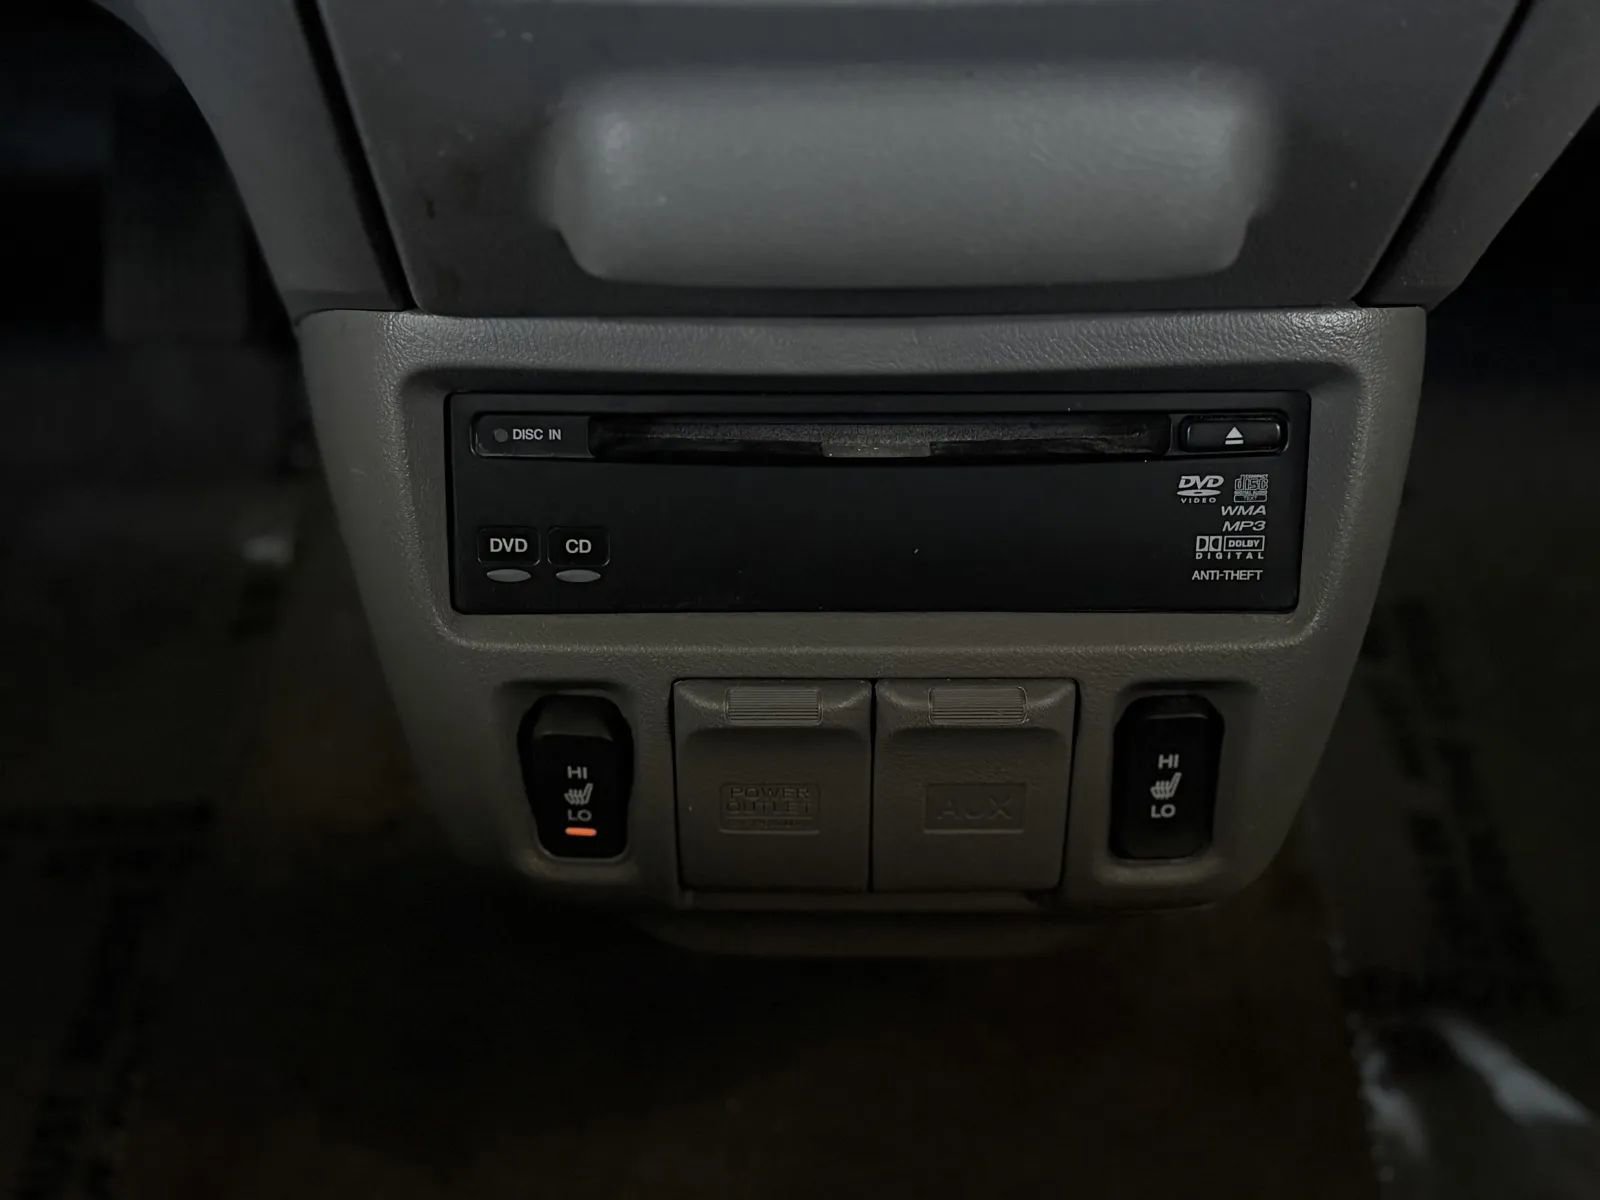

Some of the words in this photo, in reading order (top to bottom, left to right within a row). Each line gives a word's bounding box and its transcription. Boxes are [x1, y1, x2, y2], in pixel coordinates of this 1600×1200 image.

[512, 428, 544, 441] DISC
[548, 428, 562, 441] IN
[1178, 475, 1225, 489] DVD
[1221, 505, 1267, 516] WMA
[1222, 520, 1266, 532] MP3
[489, 537, 529, 553] DVD
[564, 538, 593, 554] CD
[1228, 539, 1260, 548] DOLBY
[1195, 552, 1264, 560] DIGITAL
[1191, 570, 1264, 581] ANTI-THEFT
[1157, 753, 1180, 770] HI
[567, 765, 588, 780] HI
[730, 787, 810, 799] POWER
[935, 794, 1014, 820] AUX
[1150, 803, 1177, 819] LO
[567, 807, 593, 822] LO
